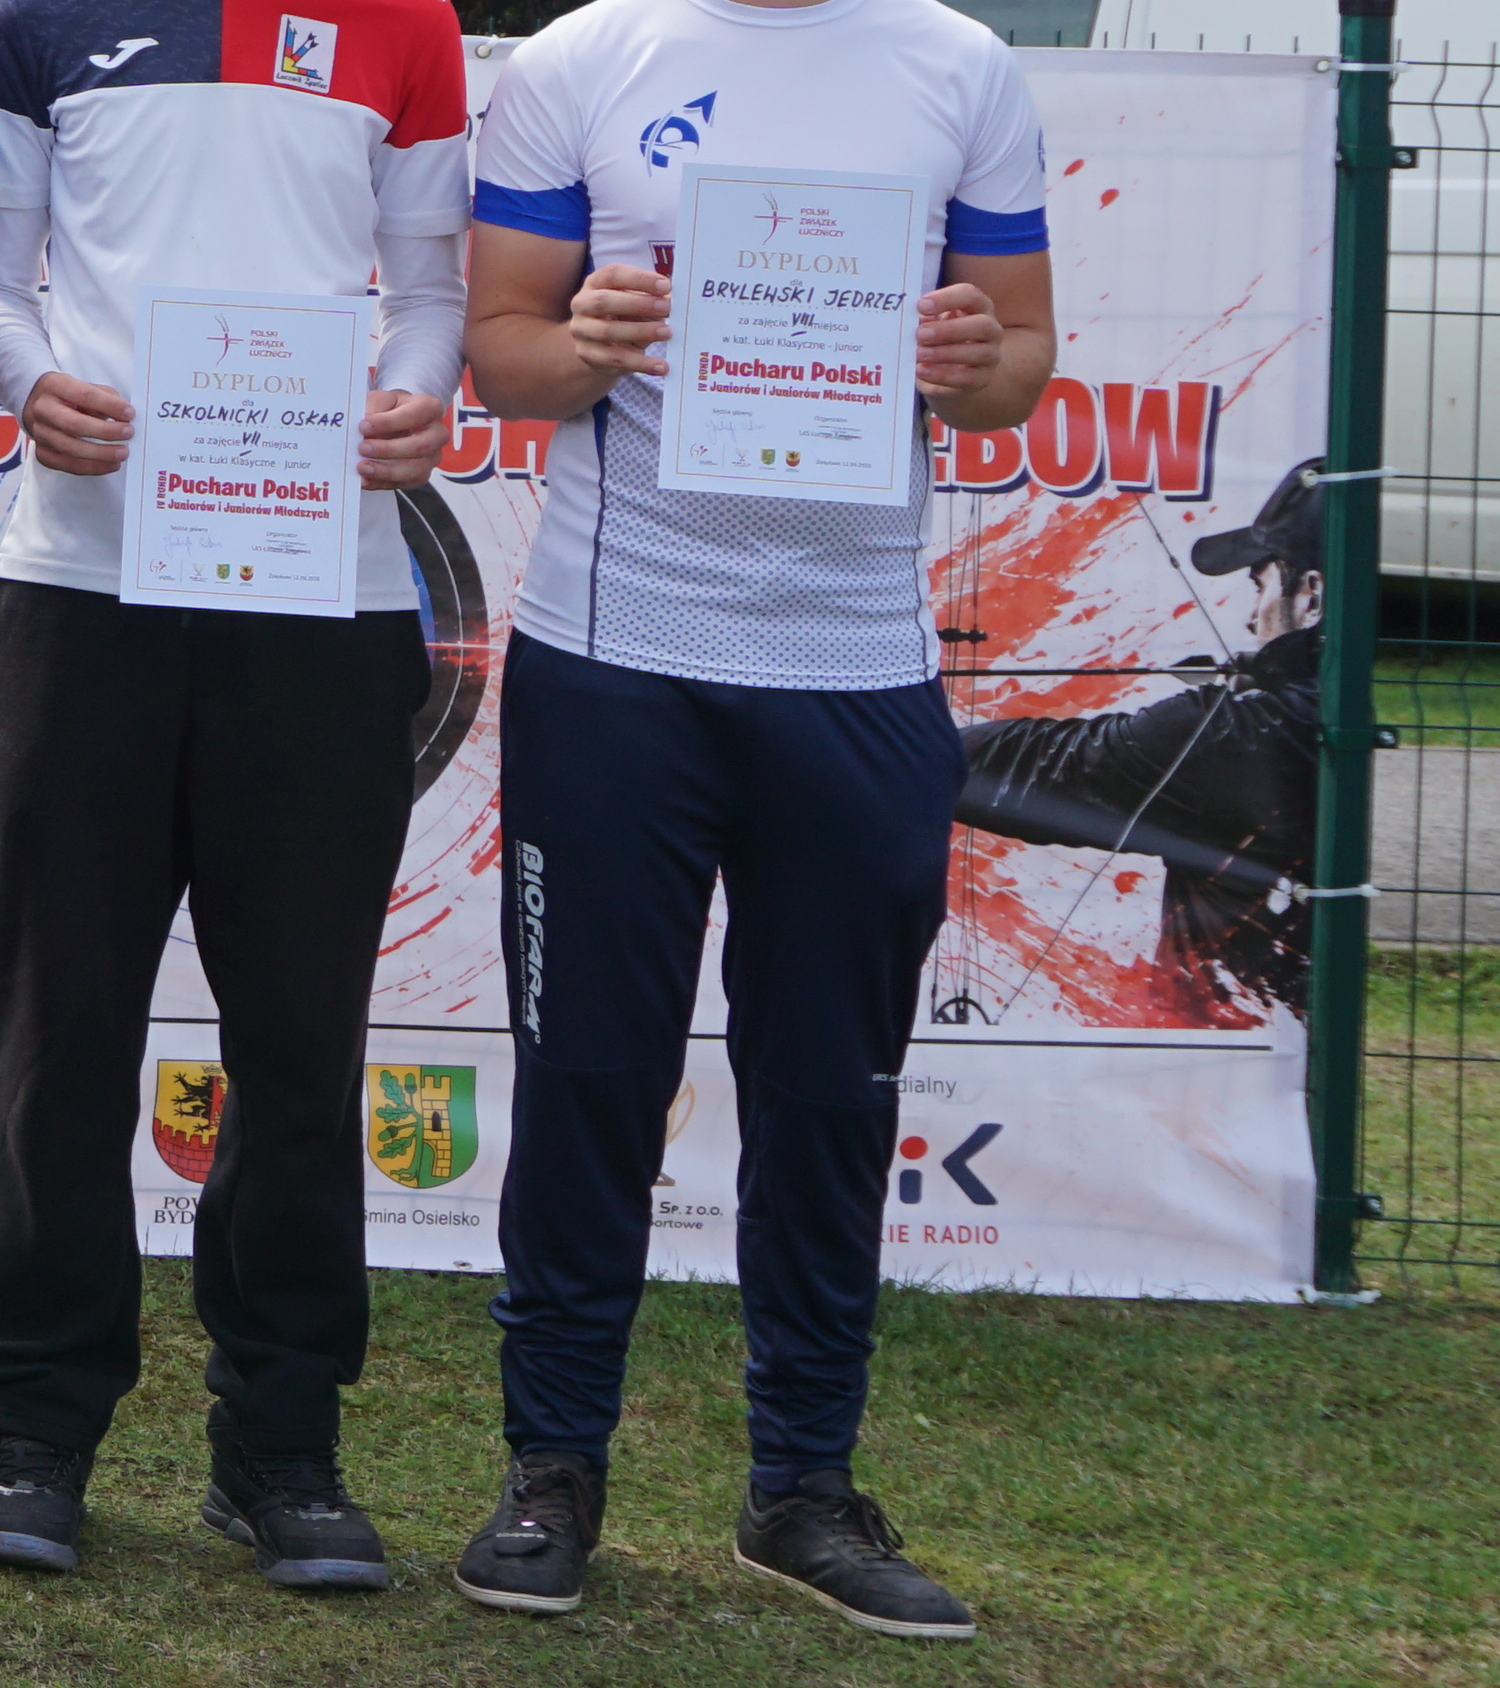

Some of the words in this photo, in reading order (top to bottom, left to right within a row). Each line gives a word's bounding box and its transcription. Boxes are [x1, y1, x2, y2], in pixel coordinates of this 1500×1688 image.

[737, 249, 860, 275] DYPLOM
[701, 279, 815, 304] BRYLEWSKI
[192, 371, 307, 395] DYPLOM
[710, 354, 804, 381] Pucharu
[811, 361, 883, 387] Polski
[709, 381, 760, 396] Juniorów
[763, 383, 767, 396] i
[769, 384, 820, 399] Juniorów
[823, 389, 883, 406] Młodszych
[157, 401, 268, 425] SZKOLNICKI
[281, 410, 345, 429] OSKAR
[168, 473, 257, 498] Pucharu
[263, 479, 330, 502] Polski
[168, 499, 215, 512] Juniorów
[218, 501, 222, 512] i
[224, 503, 271, 516] Juniorów
[274, 506, 330, 521] Młodszych
[522, 841, 545, 1034] BIOFARM
[412, 1210, 481, 1227] Osielsko
[924, 1225, 999, 1245] RADIO
